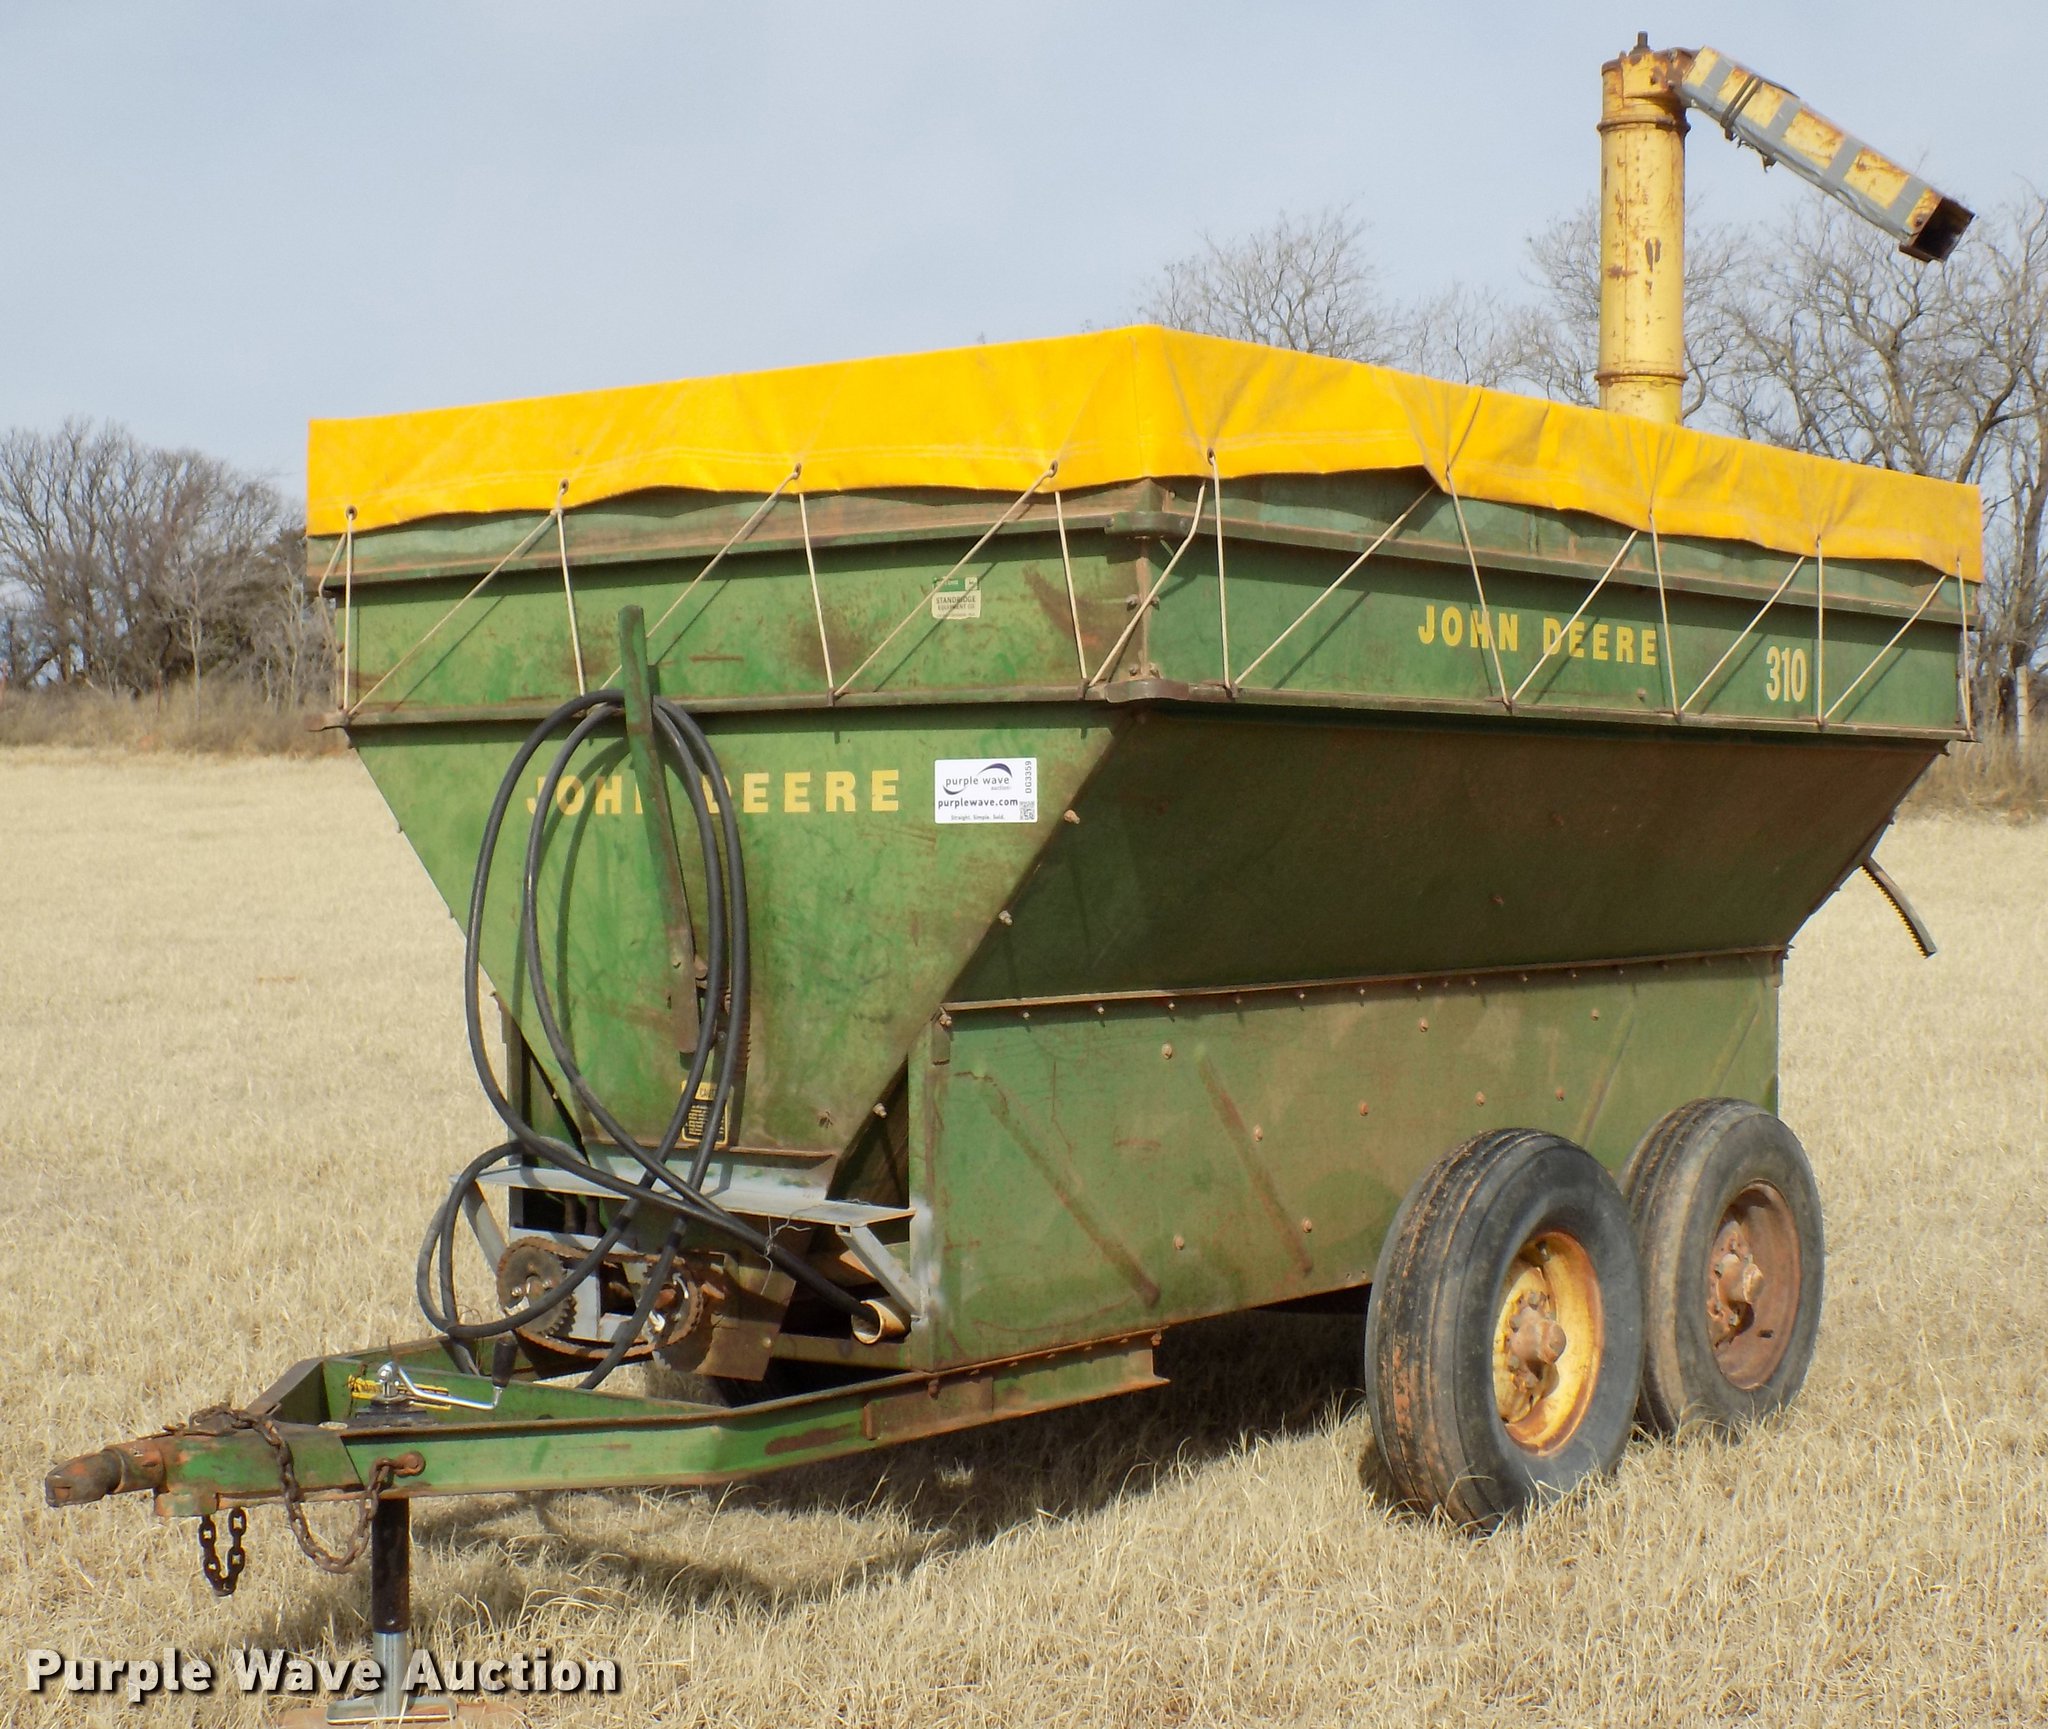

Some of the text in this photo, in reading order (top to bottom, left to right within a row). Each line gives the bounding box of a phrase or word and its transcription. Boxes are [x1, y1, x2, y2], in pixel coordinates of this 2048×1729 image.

[1418, 605, 1657, 666] JOHN DEERE
[1766, 645, 1808, 703] 310
[527, 775, 643, 816] JOH
[945, 776, 1010, 787] purple wave
[938, 797, 1018, 809] purplewave.com
